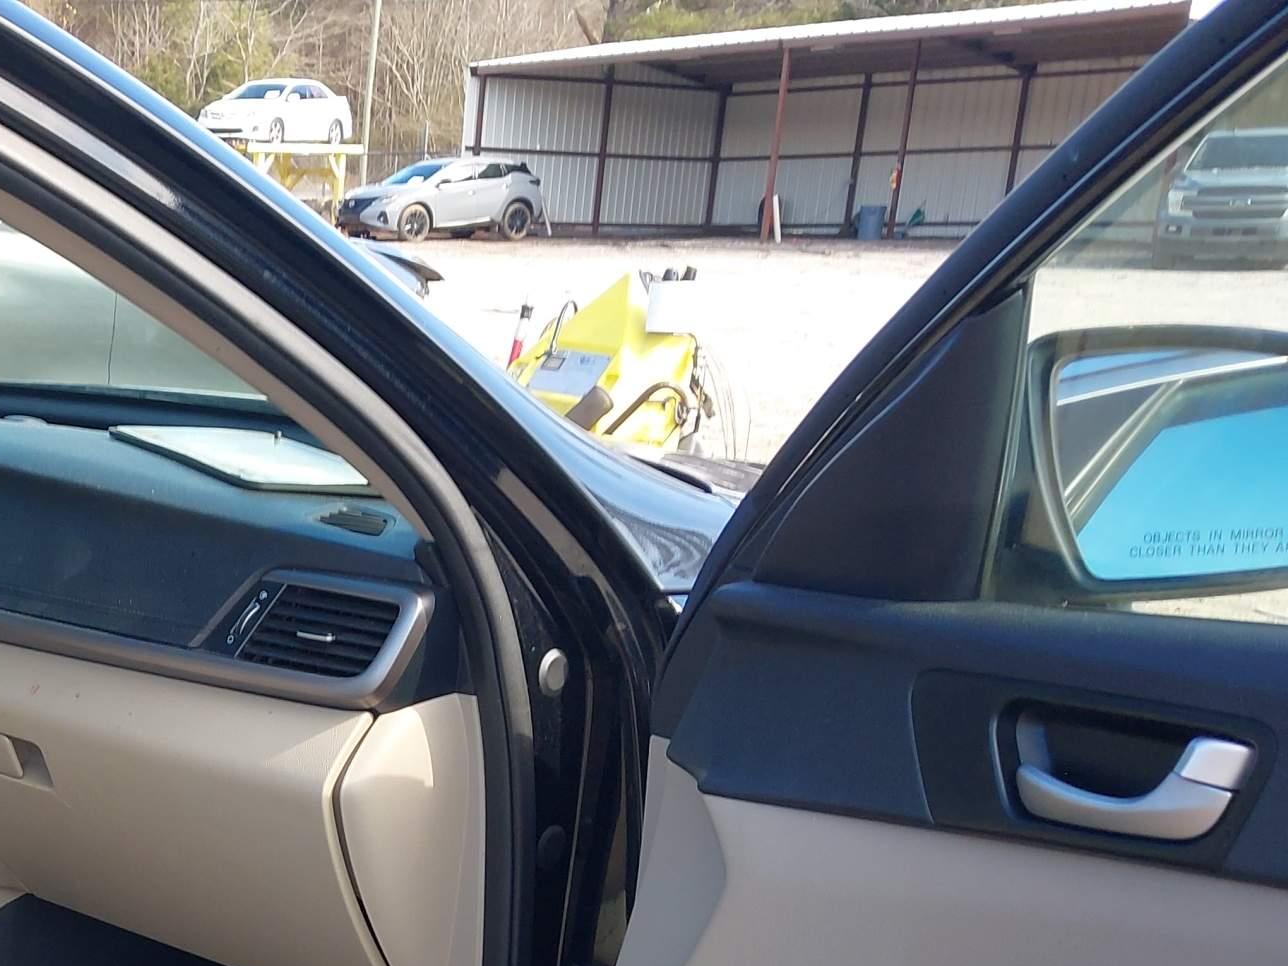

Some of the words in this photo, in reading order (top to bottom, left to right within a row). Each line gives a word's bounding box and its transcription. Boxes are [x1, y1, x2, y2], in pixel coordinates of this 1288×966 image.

[1143, 529, 1201, 544] OBJECTS
[1209, 528, 1223, 542] IN
[1230, 527, 1284, 541] MIRROR
[1129, 544, 1182, 558] CLOSER
[1190, 543, 1225, 556] THAN
[1234, 542, 1268, 554] THEY
